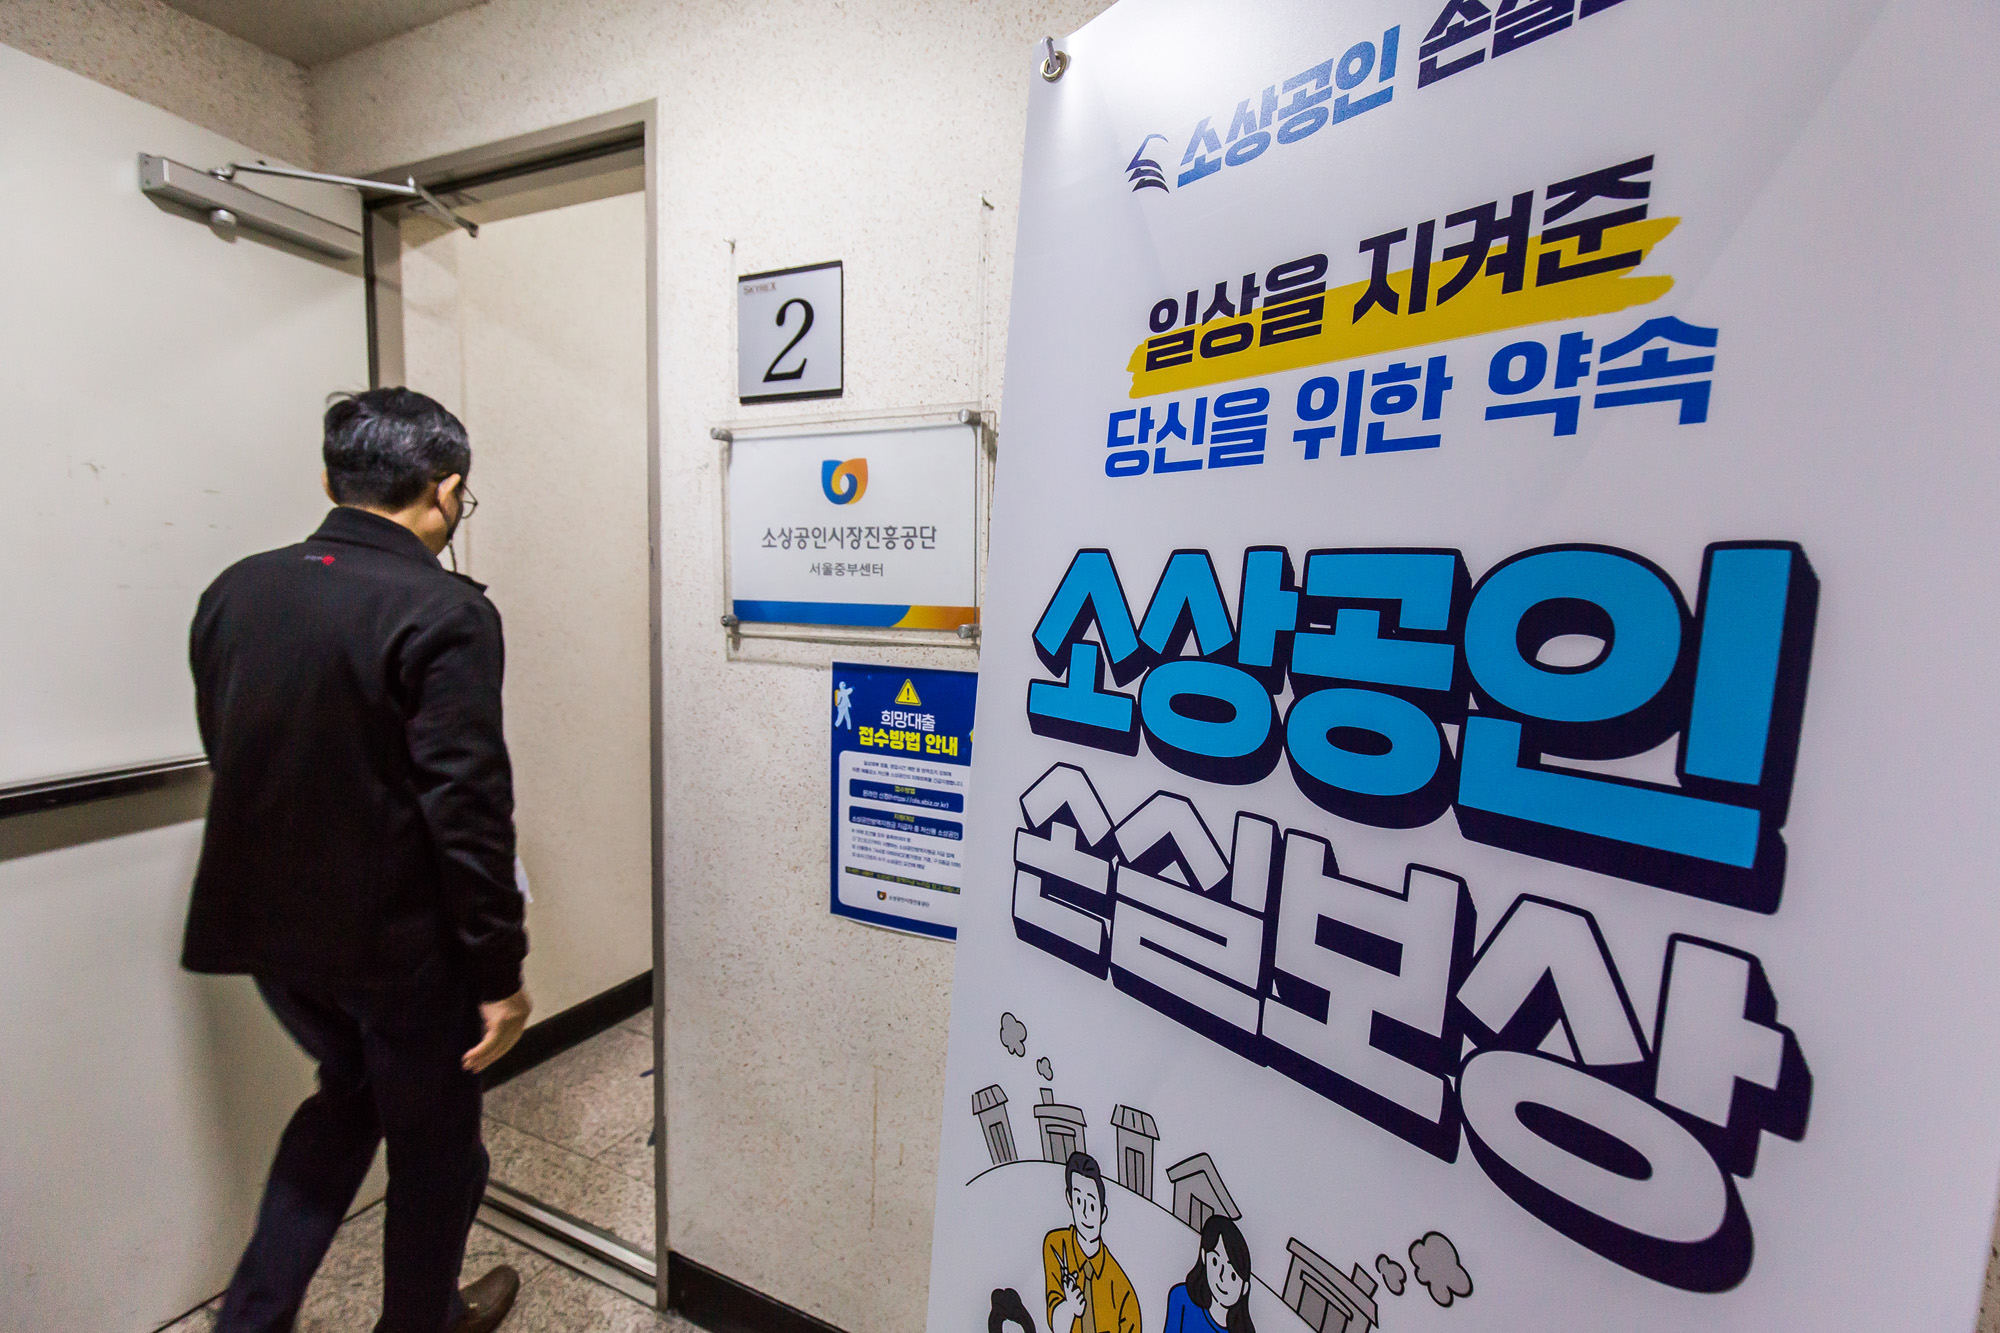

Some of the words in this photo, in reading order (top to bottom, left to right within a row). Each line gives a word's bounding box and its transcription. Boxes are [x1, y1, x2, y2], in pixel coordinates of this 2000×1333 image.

[1177, 24, 1400, 188] 소상공인
[1418, 0, 1626, 89] 손실
[1144, 253, 1329, 372] 일상을
[1352, 154, 1655, 328] 지켜준
[762, 297, 815, 383] 2
[1104, 386, 1271, 479] 당신을
[1293, 355, 1453, 461] 위한
[1485, 315, 1719, 437] 약속
[761, 525, 937, 551] 소상공인시장진흥공단
[809, 562, 884, 578] 서울중부센터
[858, 726, 921, 752] 접수방법
[925, 733, 959, 757] 안내
[880, 709, 936, 732] 희망대출
[1026, 540, 1821, 914] 소상공인
[1012, 762, 1814, 1294] 손실보상
